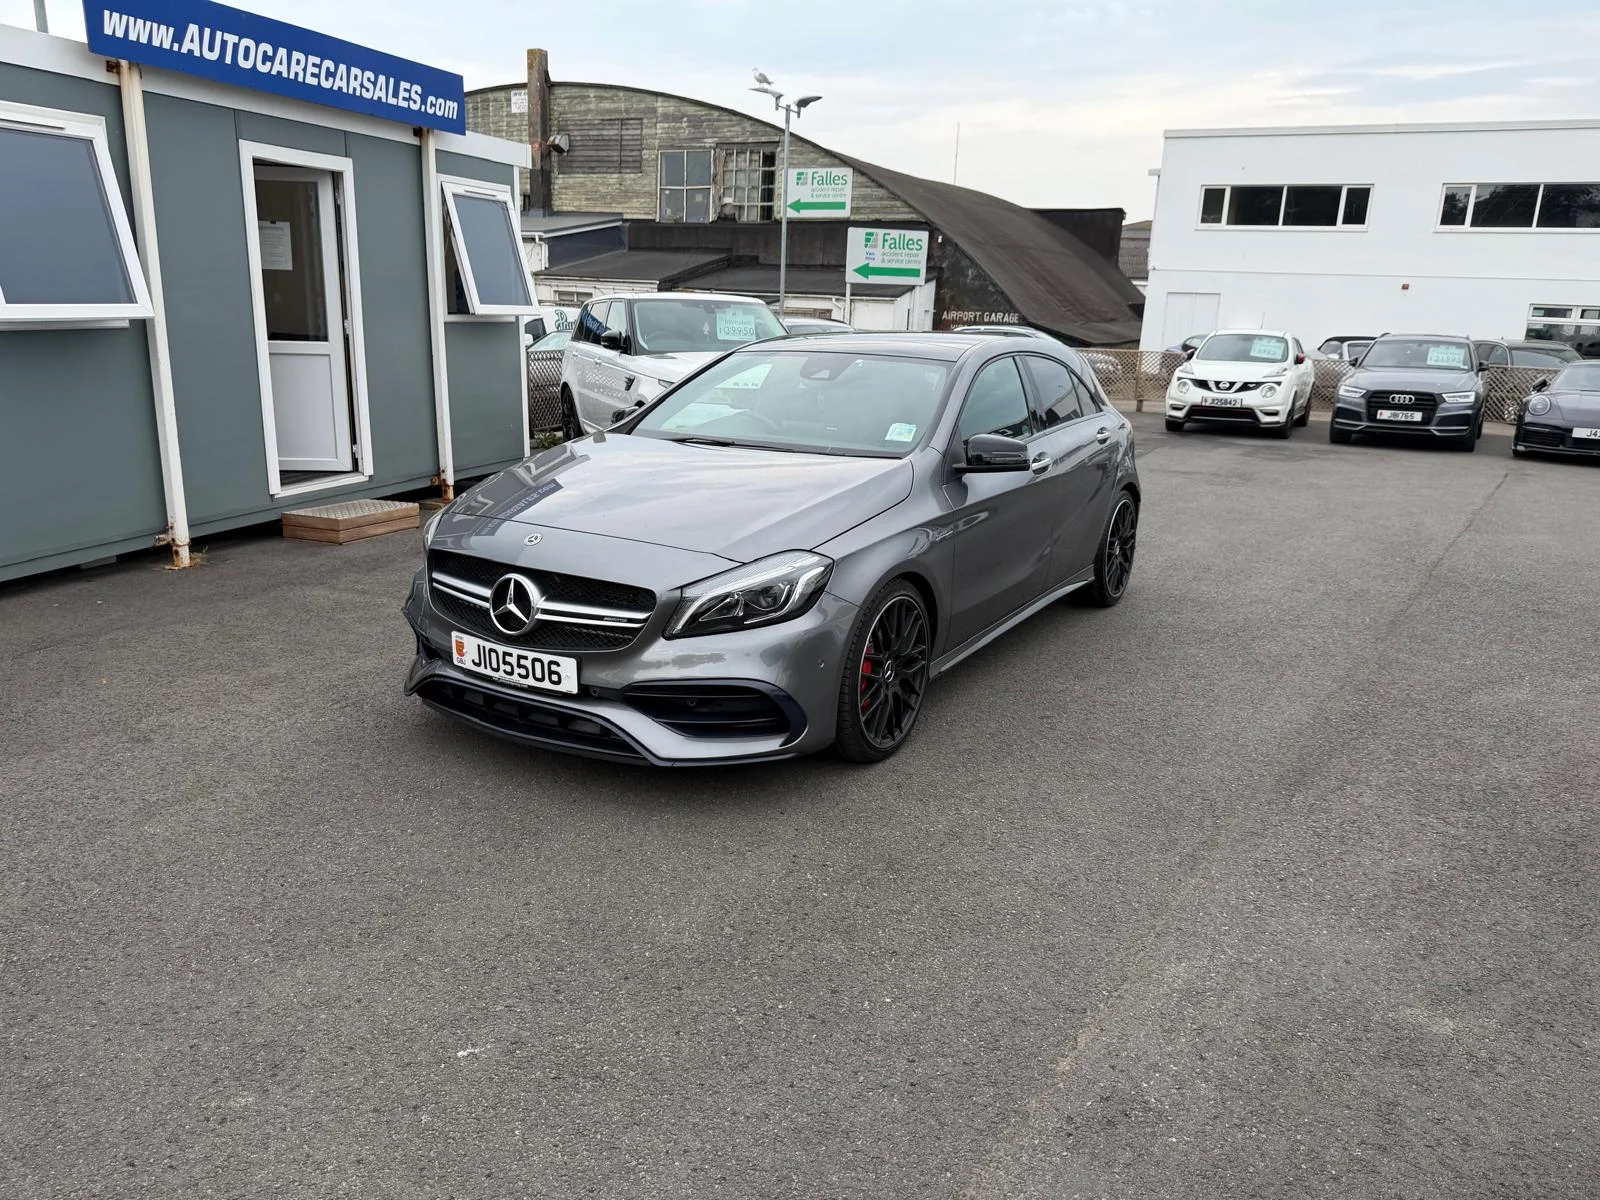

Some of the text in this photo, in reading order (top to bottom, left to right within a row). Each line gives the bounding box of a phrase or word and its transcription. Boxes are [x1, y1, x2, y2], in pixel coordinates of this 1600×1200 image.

[103, 9, 459, 121] www.AUTOCARECARSALES.com
[811, 171, 848, 186] Falles
[881, 232, 923, 251] Falles
[942, 311, 1020, 323] AIRPORT GARAGE
[1586, 430, 1600, 438] J4
[471, 643, 562, 686] J105506
